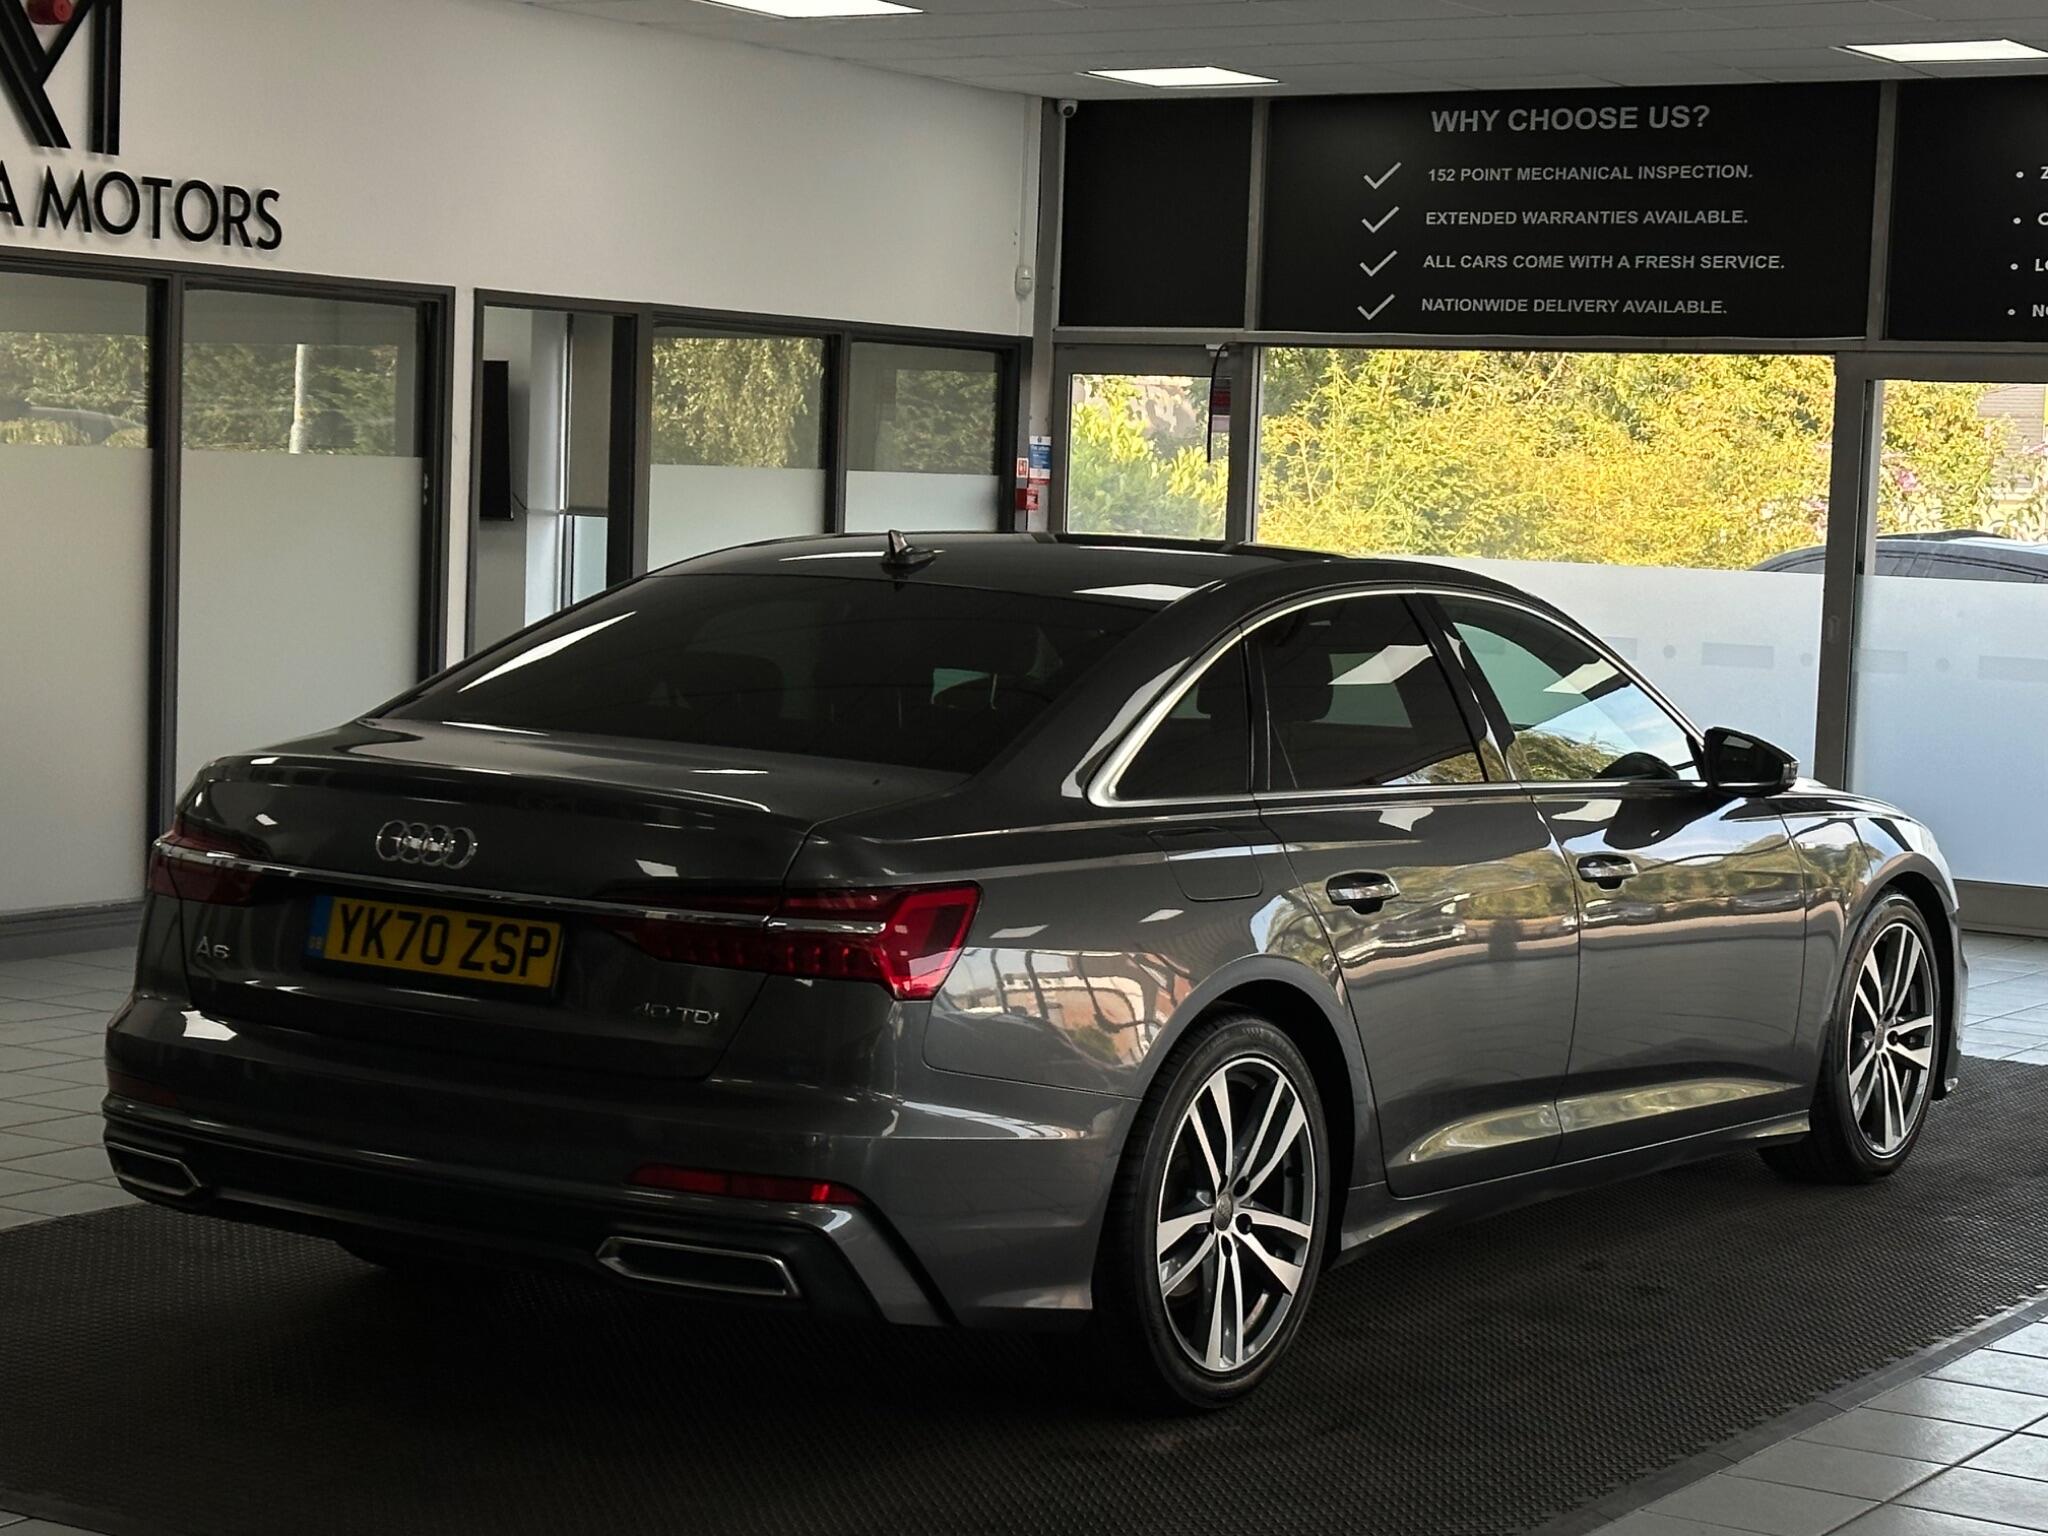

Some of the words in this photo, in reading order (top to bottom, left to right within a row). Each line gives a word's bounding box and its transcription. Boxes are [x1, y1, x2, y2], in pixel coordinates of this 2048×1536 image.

[1431, 109, 1500, 133] WHY
[1508, 106, 1638, 132] CHOOSE
[1649, 104, 1711, 130] US?
[1428, 168, 1456, 182] 152
[1460, 167, 1513, 182] POINT
[1516, 166, 1634, 181] MECHANICAL
[1638, 164, 1753, 180] INSPECTION.
[38, 165, 282, 250] MOTORS
[1425, 211, 1518, 226] EXTENDED
[1521, 210, 1639, 225] WARRANTIES
[1642, 209, 1749, 224] AVAILABLE.
[1422, 254, 1457, 269] ALL
[1459, 254, 1508, 269] CARS
[1512, 254, 1564, 269] COME
[1568, 255, 1613, 269] WITH
[1617, 255, 1631, 269] A
[1634, 255, 1695, 269] FRESH
[1699, 255, 1785, 269] SERVICE.
[1421, 297, 1528, 312] NATIONWIDE
[1533, 298, 1620, 313] DELIVERY
[1622, 299, 1728, 314] AVAILABLE.
[195, 935, 231, 960] A6
[340, 904, 451, 966] YK70
[458, 918, 552, 977] ZSP
[675, 1006, 720, 1025] TDI
